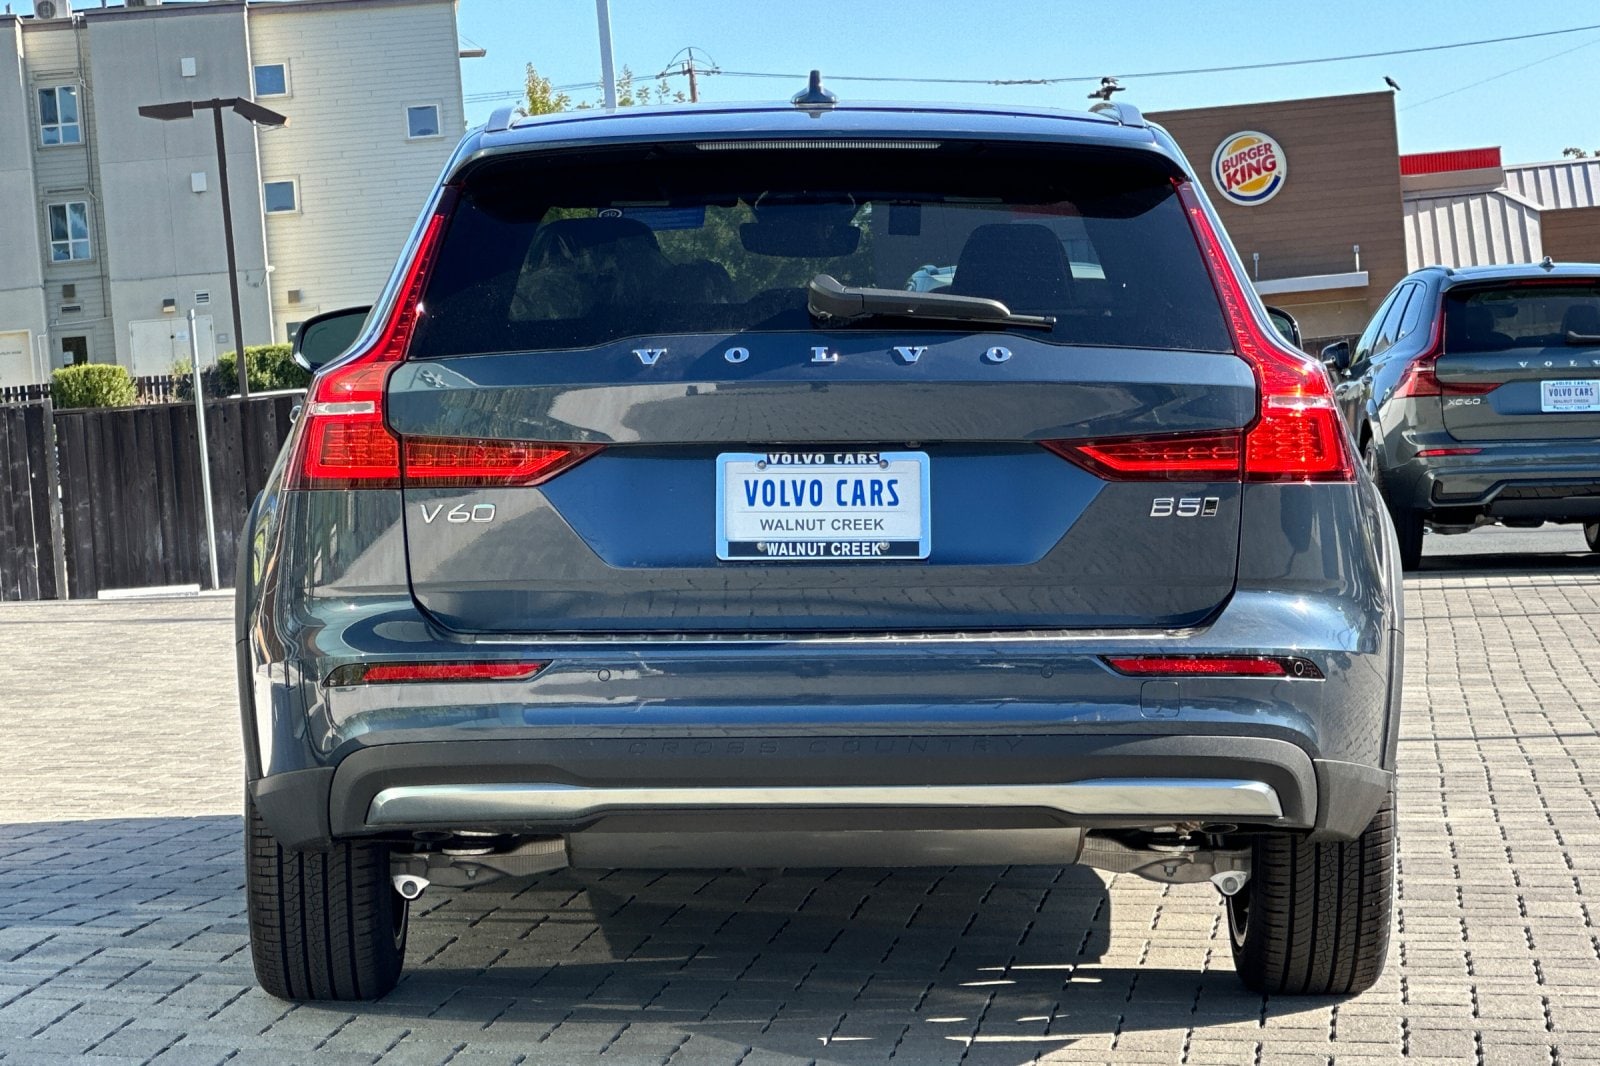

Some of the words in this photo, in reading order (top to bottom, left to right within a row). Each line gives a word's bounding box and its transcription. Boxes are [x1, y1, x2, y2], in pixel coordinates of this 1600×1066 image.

[1222, 143, 1273, 173] BURGER
[1226, 154, 1276, 190] KING
[632, 345, 1013, 365] VOLVO
[1549, 388, 1572, 397] VOLVO
[1575, 387, 1593, 397] CARS
[1448, 398, 1481, 406] XC60
[769, 453, 825, 465] VOLVO
[833, 453, 879, 465] CARS
[744, 479, 823, 507] VOLVO
[836, 479, 900, 507] CARS
[759, 518, 826, 532] WALNUT
[831, 518, 885, 532] CREEK
[766, 542, 826, 556] WALNUT
[831, 542, 882, 556] CREEK
[628, 741, 780, 754] CROSS
[808, 738, 1024, 754] COUNTRY
